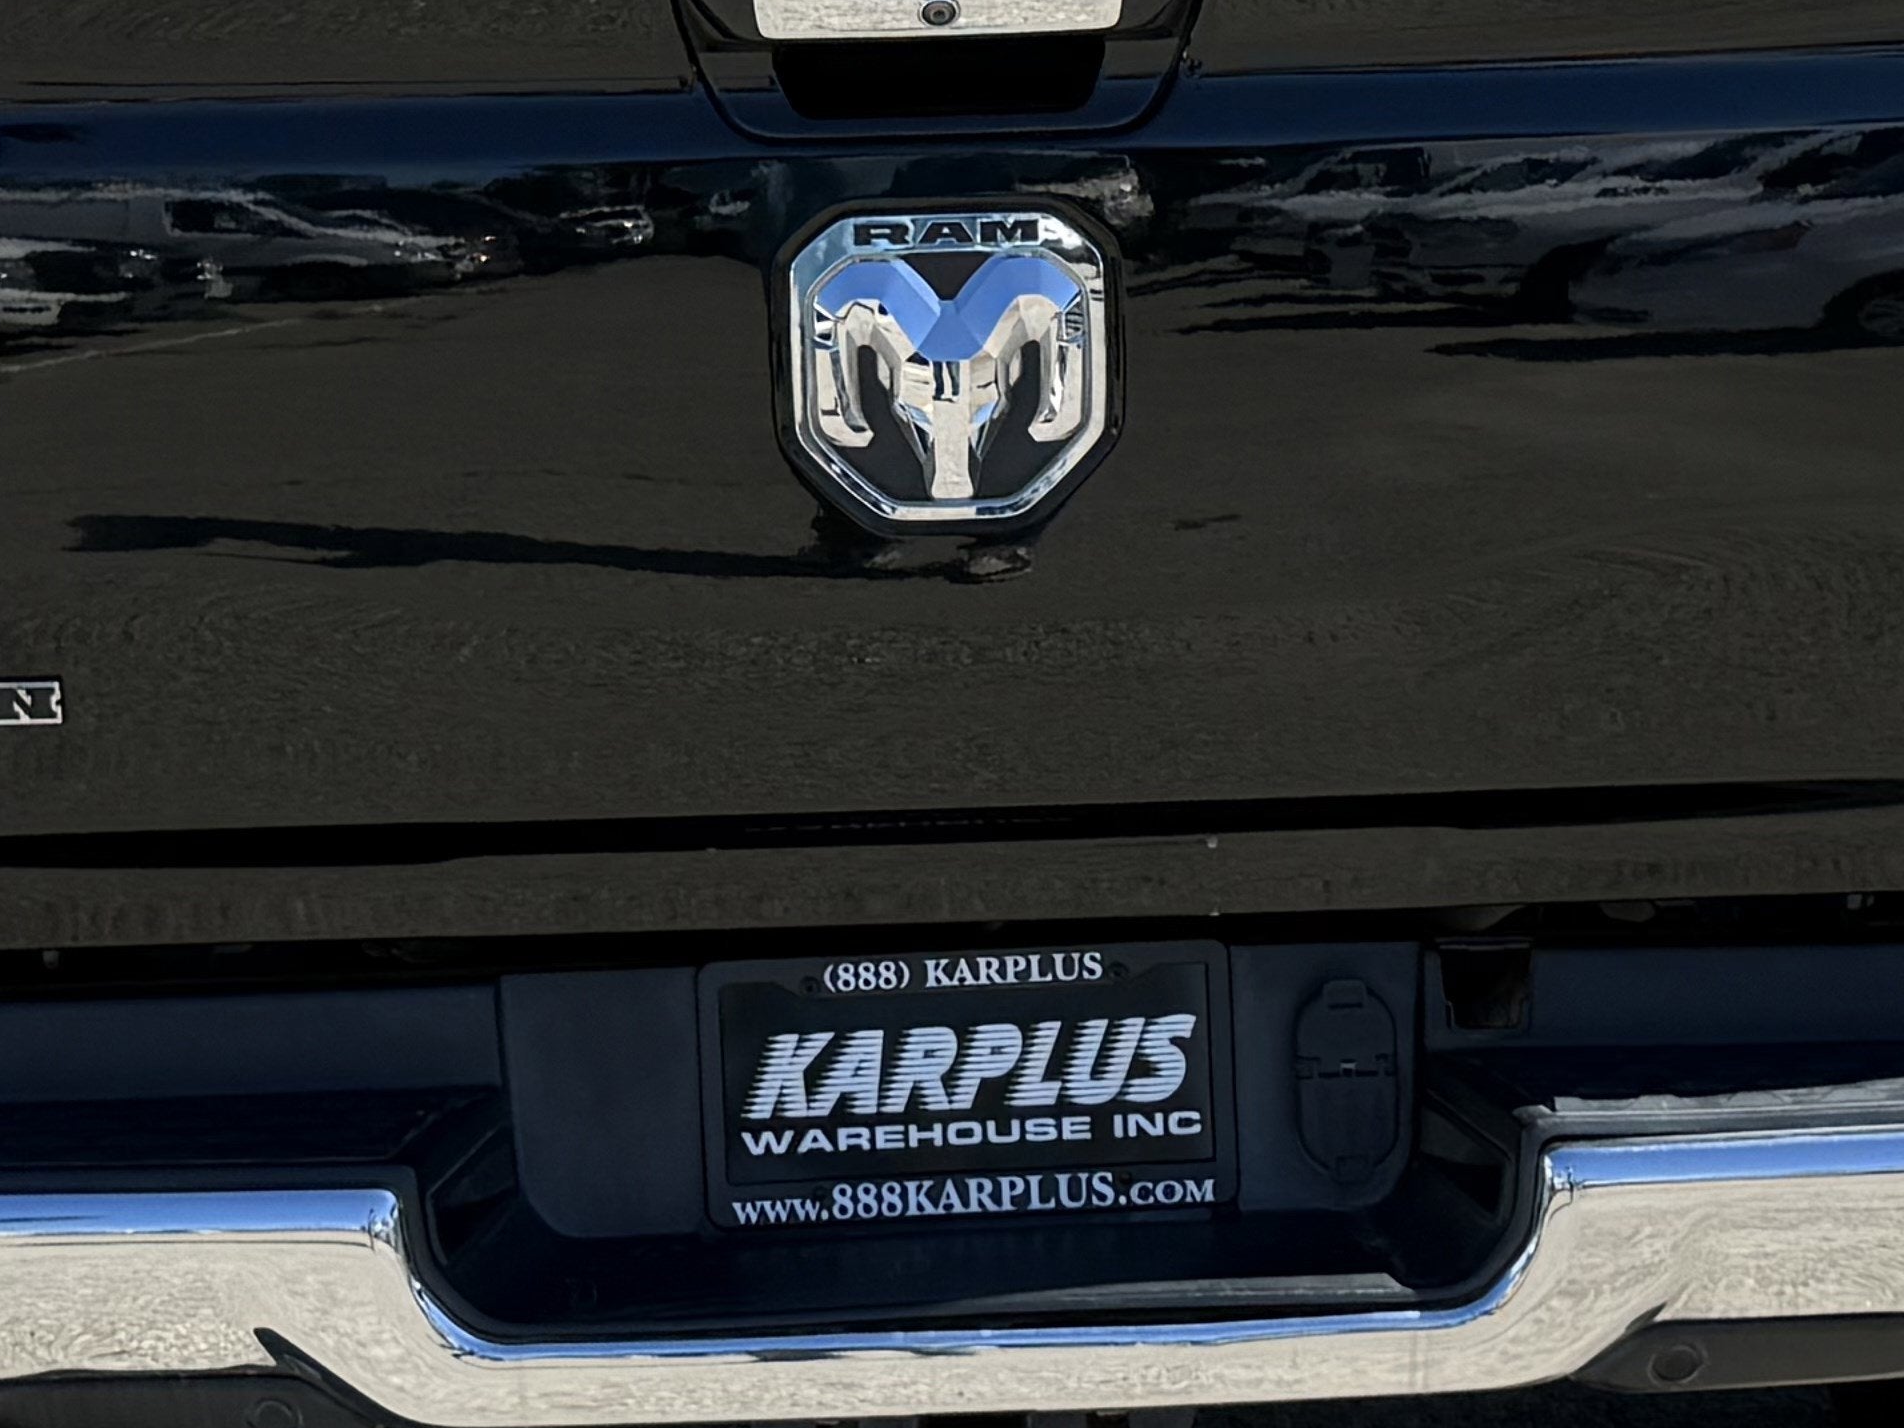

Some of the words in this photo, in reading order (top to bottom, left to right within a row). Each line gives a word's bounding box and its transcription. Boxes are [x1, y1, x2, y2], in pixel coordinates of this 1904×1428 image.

[853, 218, 1040, 247] RAM
[823, 961, 910, 995] (888)
[924, 950, 1104, 989] KARPLUS
[739, 1013, 1198, 1120] KARPLUS
[740, 1115, 1093, 1157] WAREHOUSE
[1112, 1110, 1204, 1140] INC
